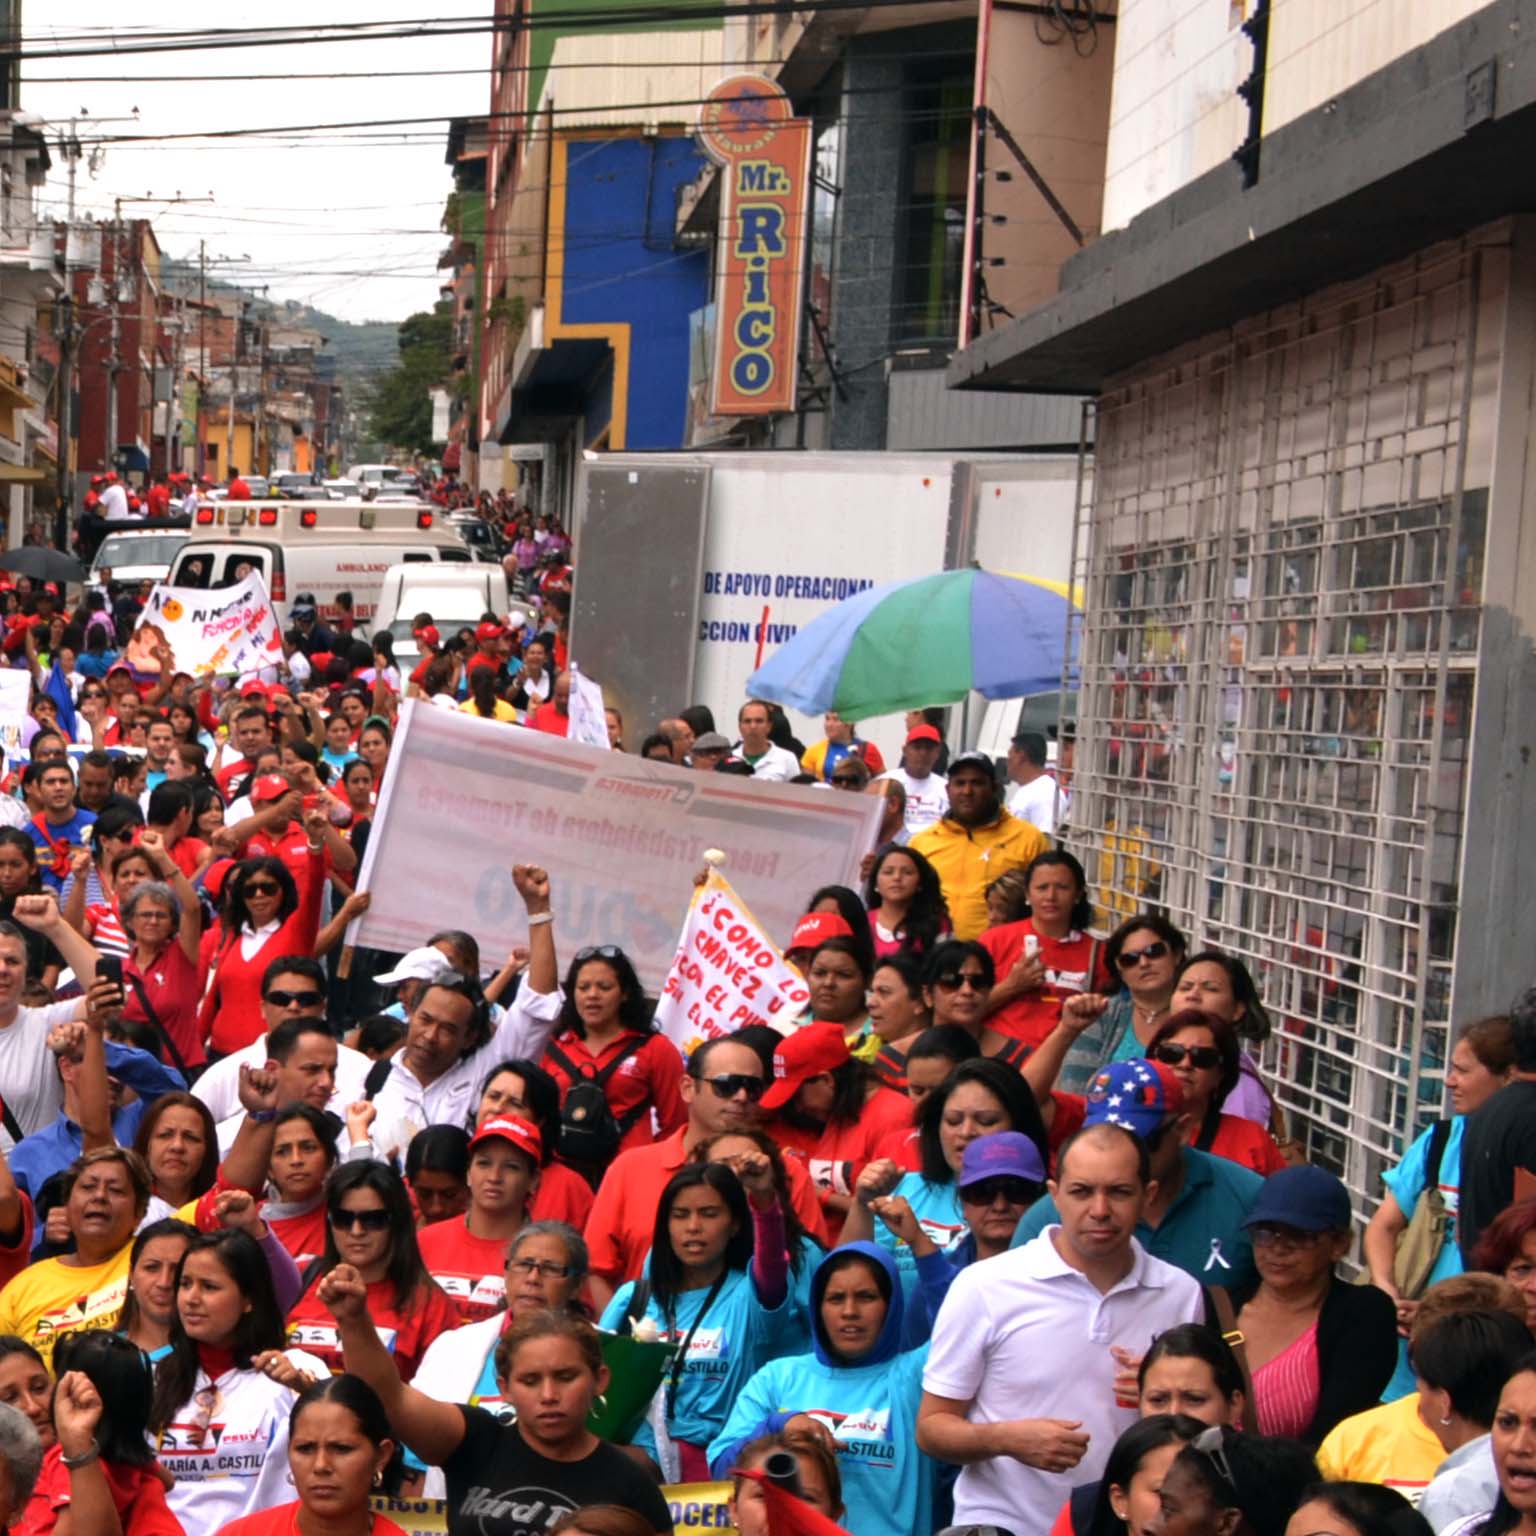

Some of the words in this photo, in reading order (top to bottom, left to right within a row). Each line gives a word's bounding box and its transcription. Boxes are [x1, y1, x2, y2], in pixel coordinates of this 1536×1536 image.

[739, 162, 789, 193] Mr.
[704, 571, 722, 595] DE
[724, 573, 772, 597] APOYO
[705, 984, 728, 1012] EL
[778, 978, 811, 1003] LO
[459, 1485, 545, 1524] Hard
